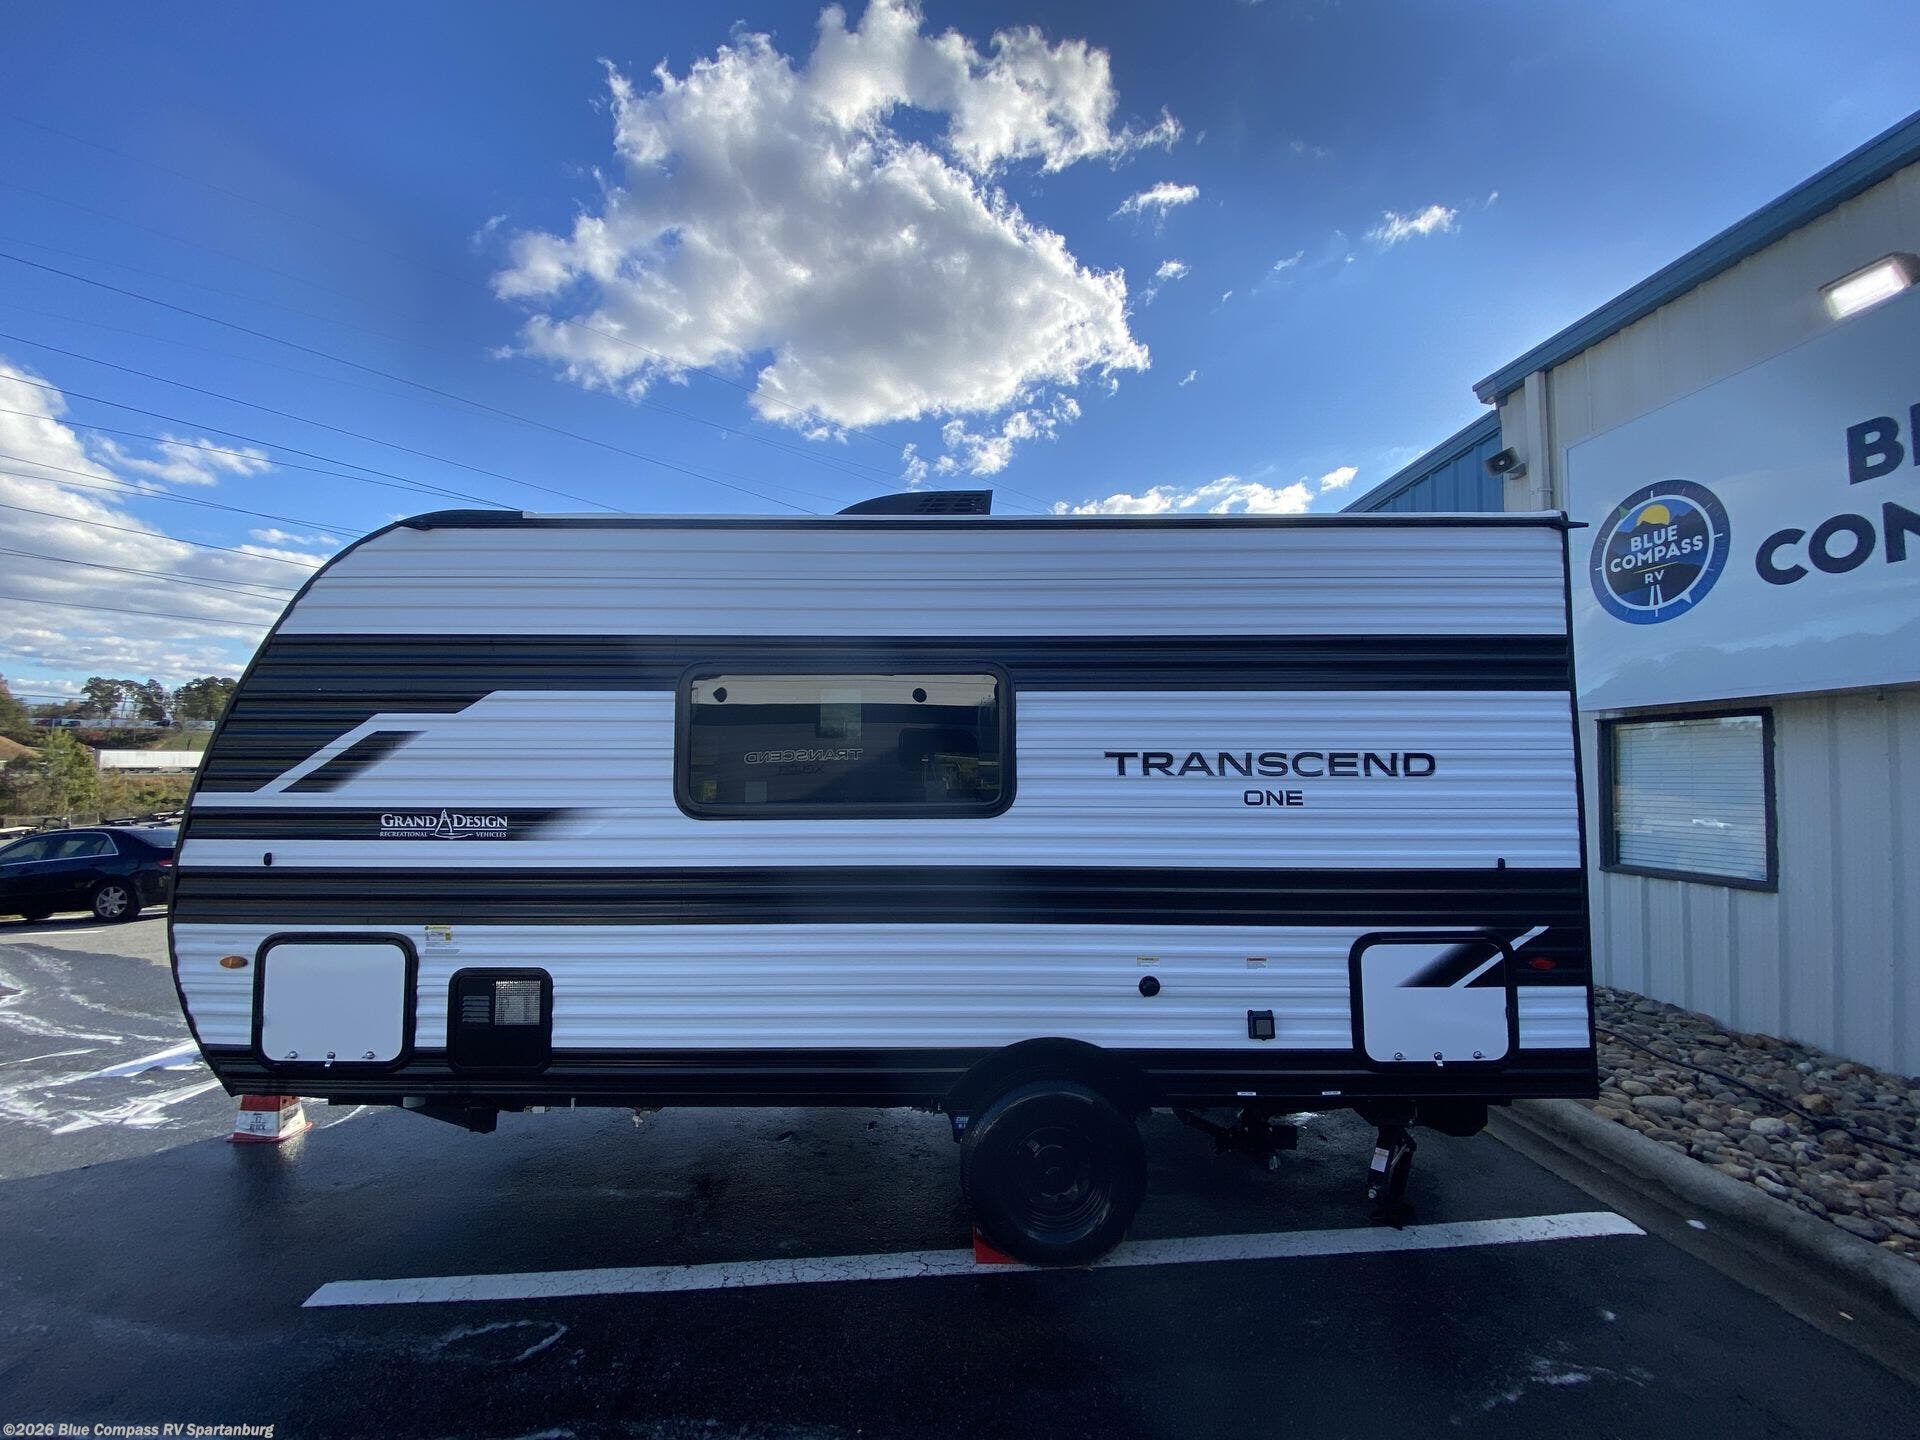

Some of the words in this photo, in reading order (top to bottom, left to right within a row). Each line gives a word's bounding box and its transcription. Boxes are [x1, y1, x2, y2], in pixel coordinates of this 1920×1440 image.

[1630, 525, 1678, 552] BLUE
[1610, 535, 1703, 573] COMPASS
[1644, 569, 1665, 584] RV
[1104, 751, 1436, 777] TRANSCEND
[1243, 790, 1304, 806] ONE
[380, 813, 437, 827] GRAND
[452, 814, 508, 828] DESIGN
